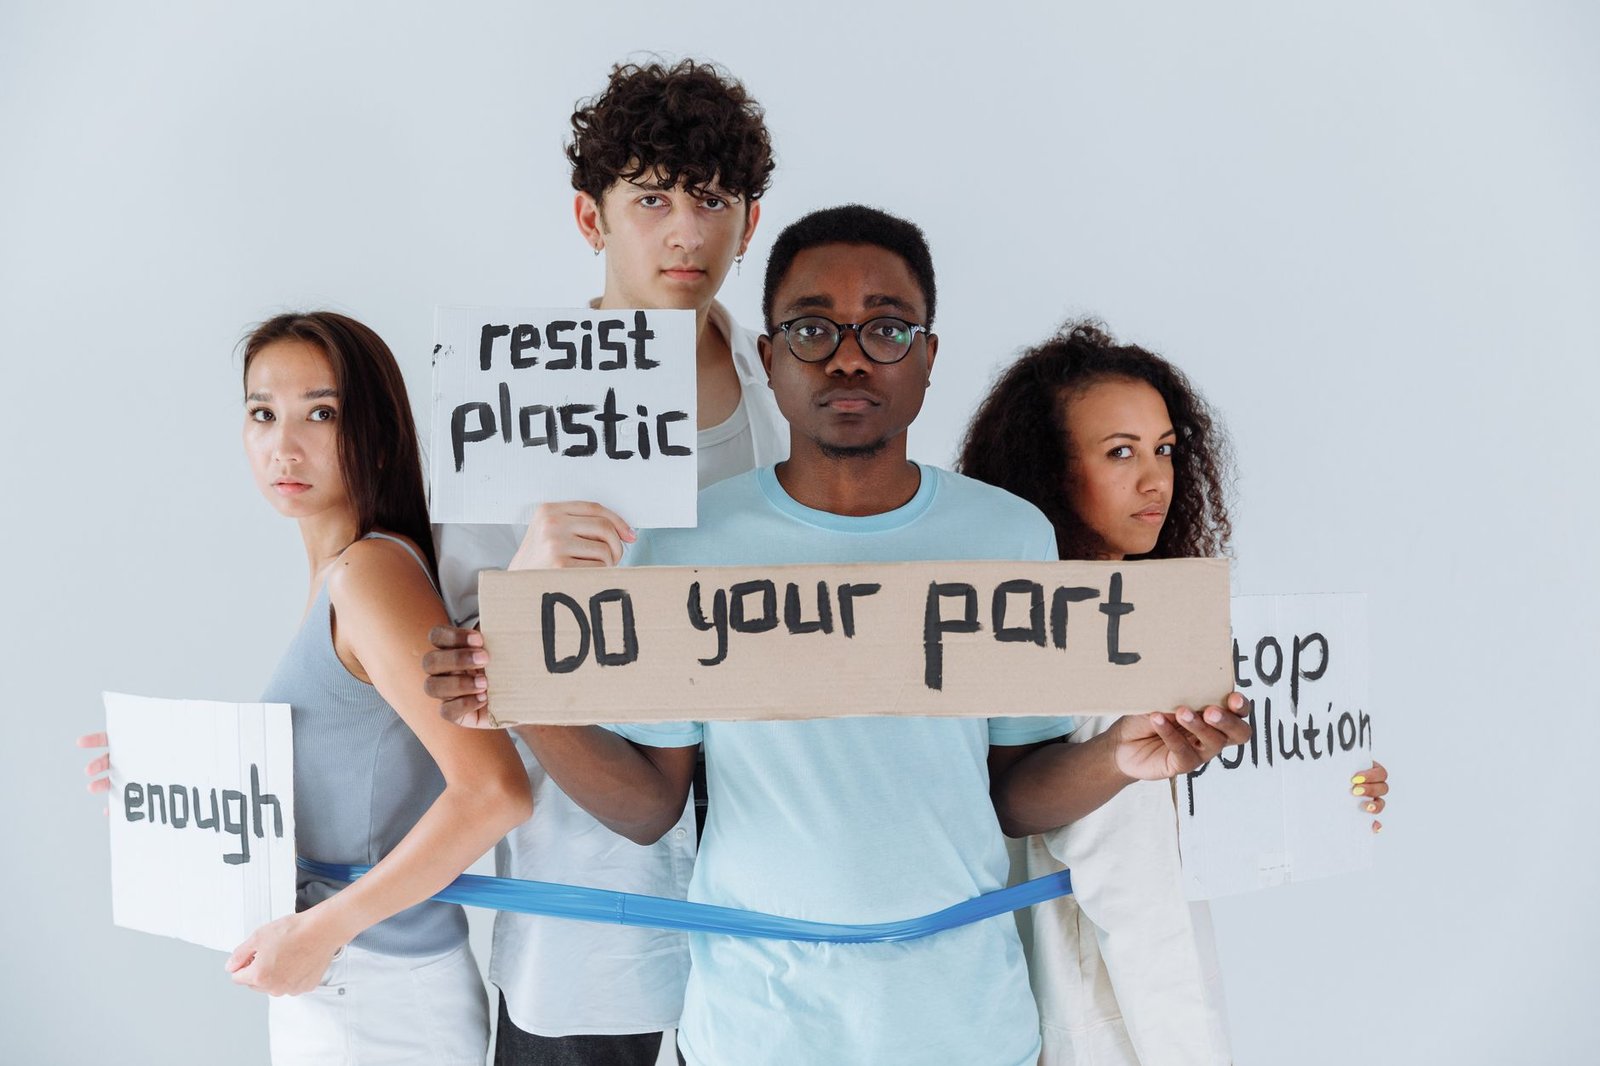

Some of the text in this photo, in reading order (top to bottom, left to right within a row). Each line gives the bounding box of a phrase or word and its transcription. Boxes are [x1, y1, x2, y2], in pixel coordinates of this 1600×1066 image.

[479, 310, 661, 371] resist
[450, 382, 693, 473] plastic
[686, 580, 882, 667] your
[923, 572, 1142, 691] part
[1232, 632, 1330, 716] top
[124, 763, 284, 865] enough
